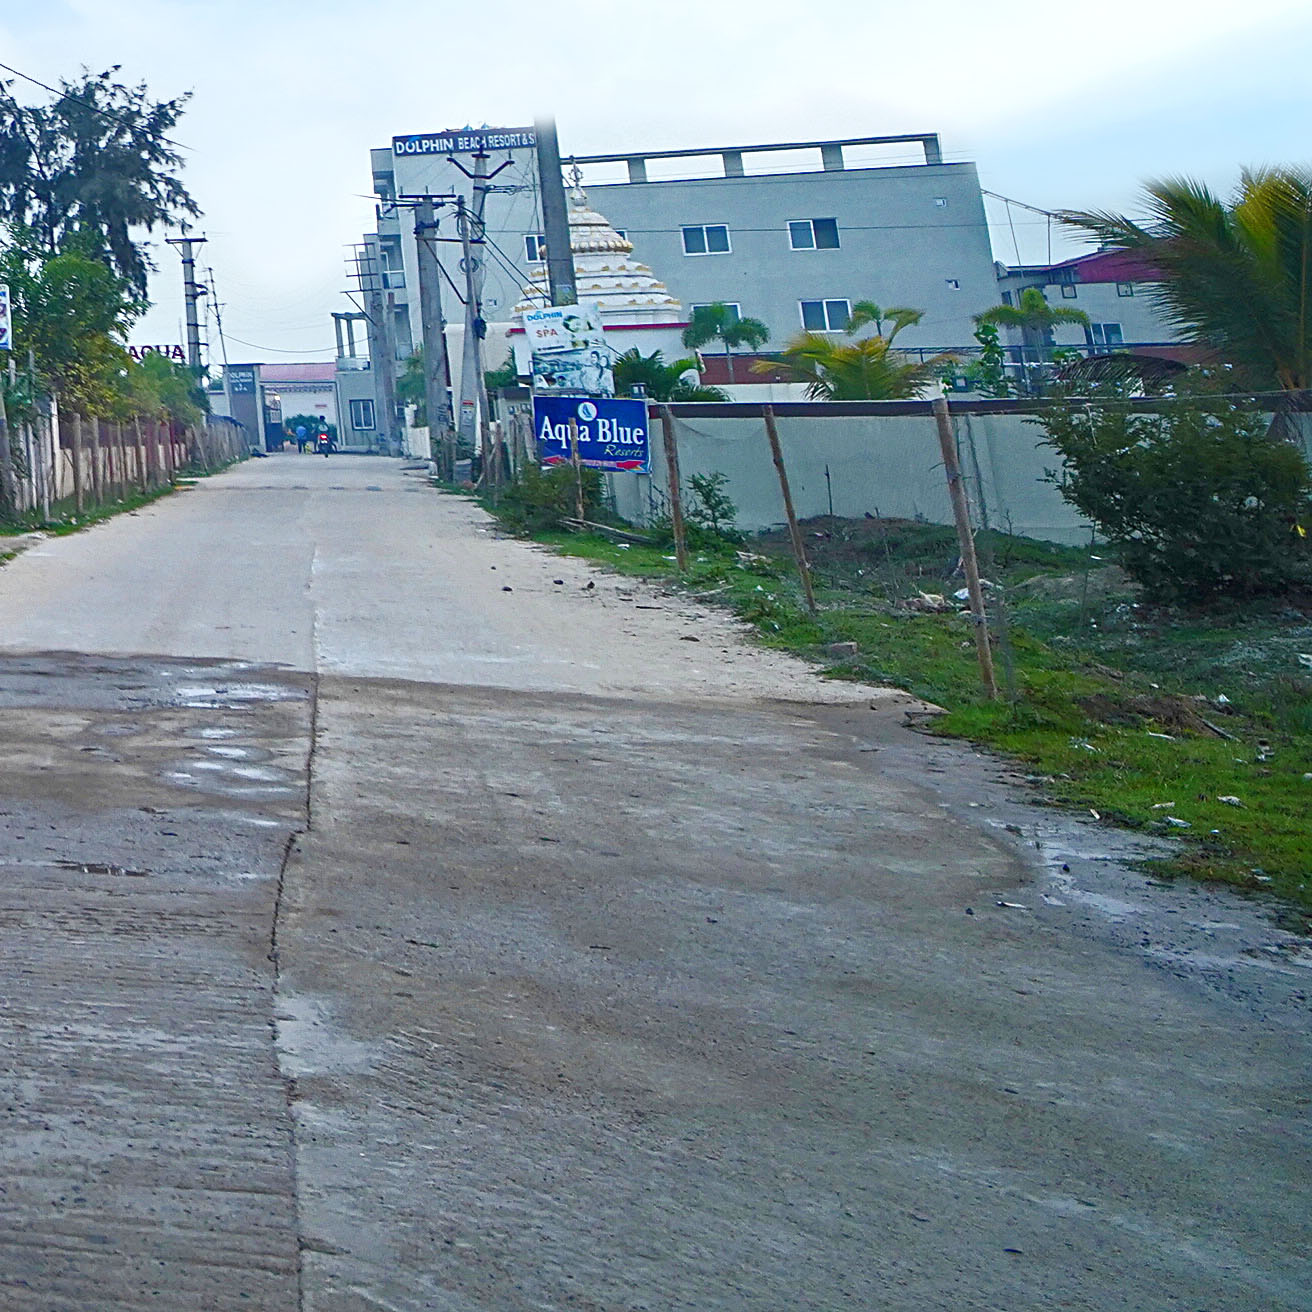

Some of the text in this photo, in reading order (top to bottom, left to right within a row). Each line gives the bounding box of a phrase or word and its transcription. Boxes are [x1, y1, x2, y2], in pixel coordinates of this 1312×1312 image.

[396, 138, 454, 154] DOLPHIN
[458, 136, 487, 150] BEACH
[488, 134, 521, 148] RESORT
[527, 312, 562, 321] DOLPHIN
[536, 329, 558, 337] SPA
[539, 416, 644, 449] Aqua Blue
